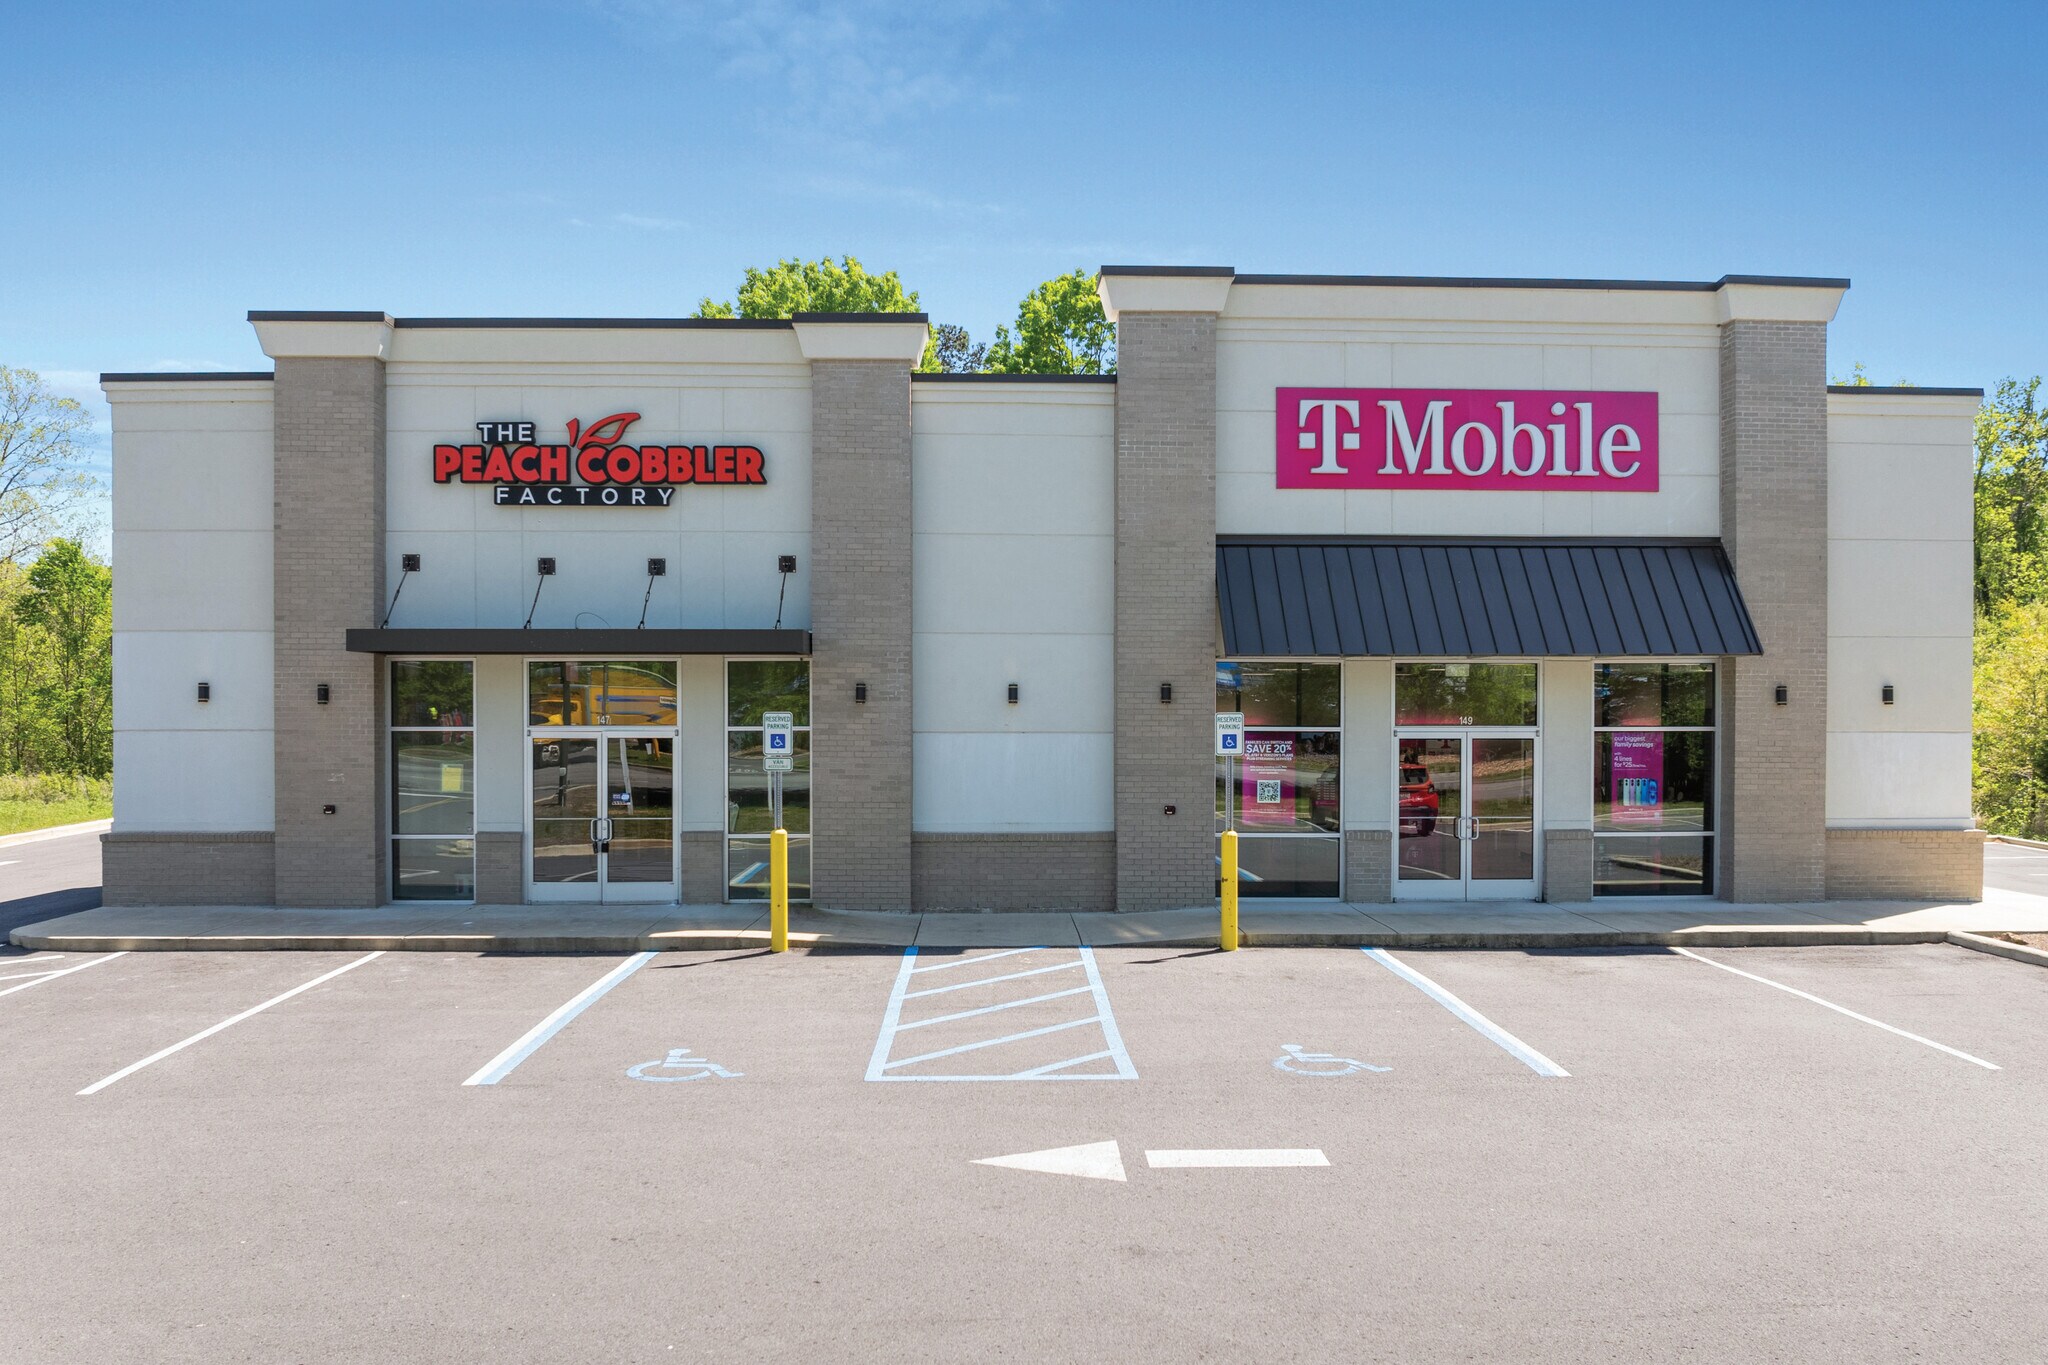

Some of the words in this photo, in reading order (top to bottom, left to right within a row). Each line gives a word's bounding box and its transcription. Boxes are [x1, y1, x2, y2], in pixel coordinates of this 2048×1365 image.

[478, 424, 533, 442] THE
[1298, 399, 1360, 474] T
[1377, 400, 1641, 478] Mobile
[434, 445, 569, 483] PEACH
[577, 445, 766, 484] COBBLER
[496, 487, 673, 505] FACTORY
[597, 715, 610, 725] 147
[1459, 716, 1473, 725] 149
[1246, 744, 1272, 753] SAVE
[1273, 744, 1292, 753] 20%
